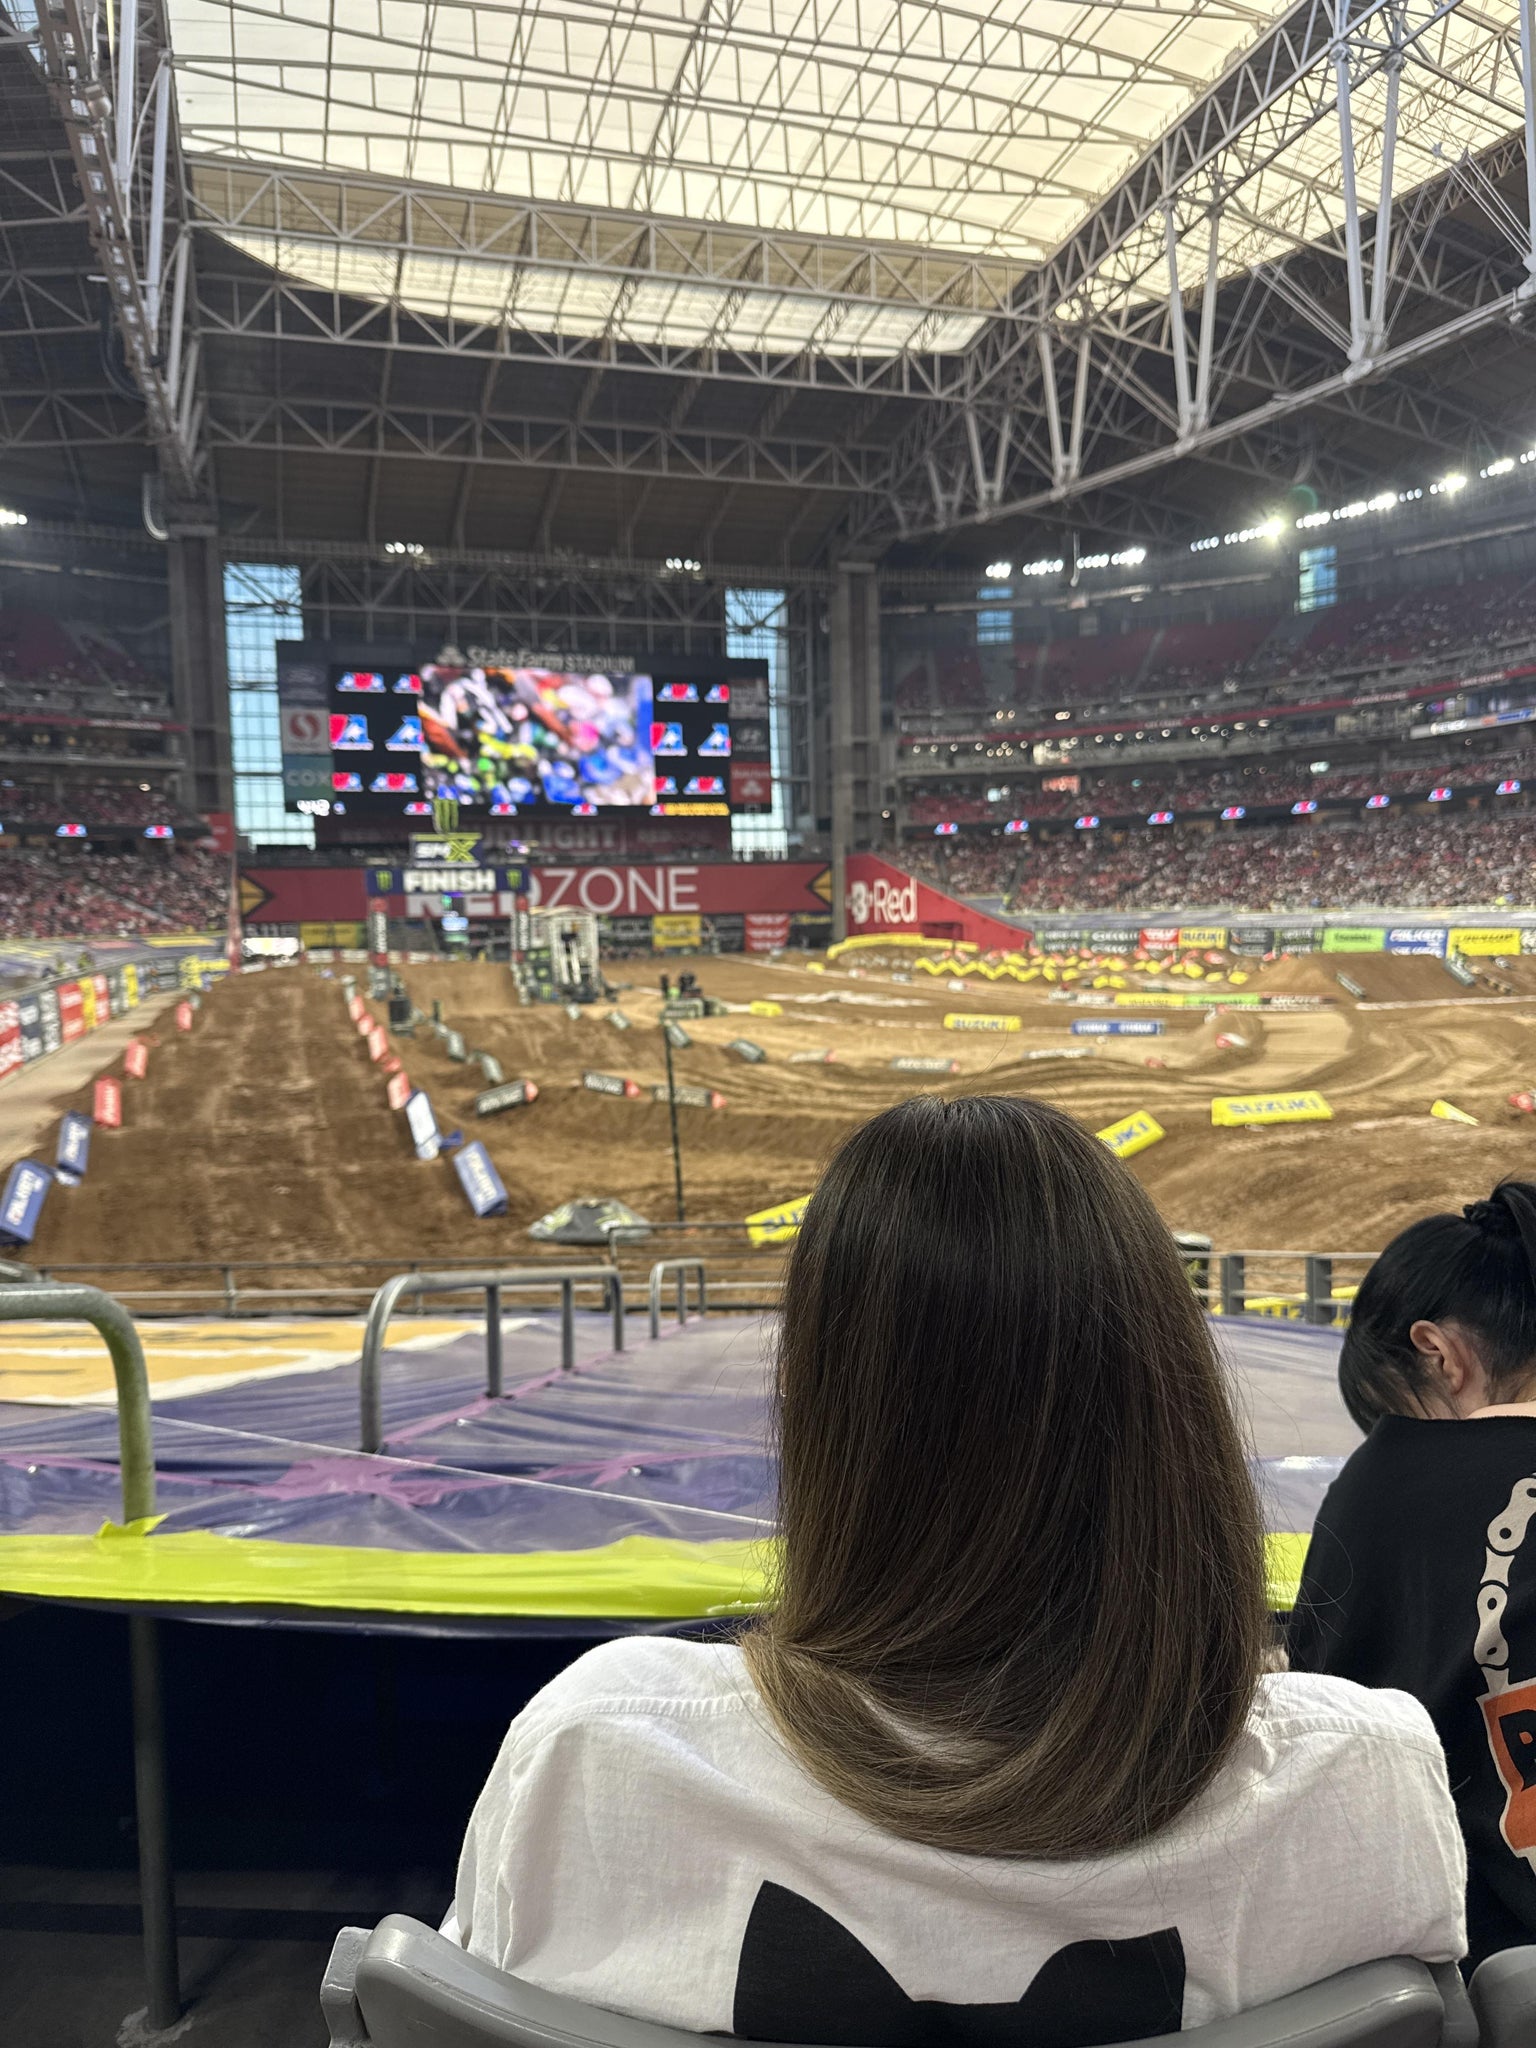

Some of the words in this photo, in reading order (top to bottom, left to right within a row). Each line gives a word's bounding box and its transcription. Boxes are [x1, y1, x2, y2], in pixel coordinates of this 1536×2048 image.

[565, 653, 635, 673] STADIUM
[285, 768, 330, 787] COX
[403, 868, 496, 893] FINISH
[1227, 1098, 1321, 1115] SUZUKI
